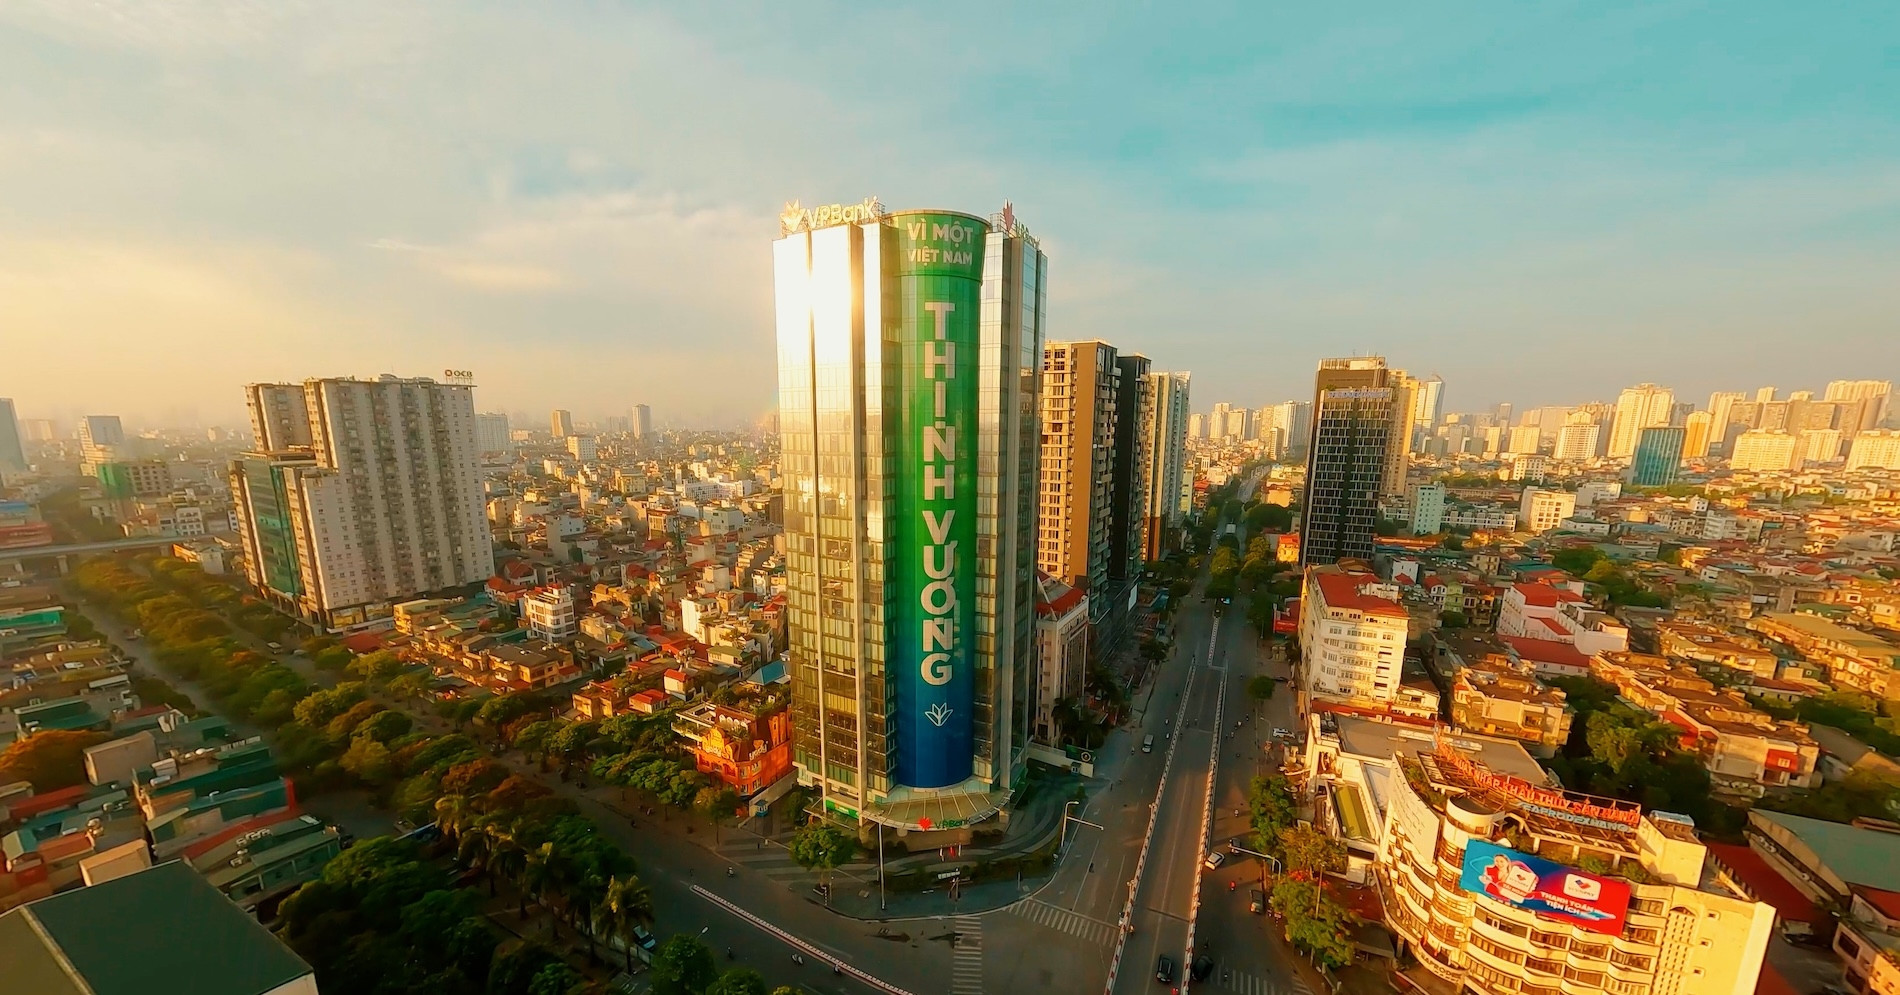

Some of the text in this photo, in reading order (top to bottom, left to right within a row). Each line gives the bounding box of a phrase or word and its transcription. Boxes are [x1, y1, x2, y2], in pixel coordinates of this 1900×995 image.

[807, 195, 877, 228] VPBank
[907, 217, 974, 248] VÌ MỘT
[907, 245, 972, 266] VIỆT NAM
[920, 302, 959, 686] THỊNH VƯỢNG
[1541, 891, 1568, 905] THANH
